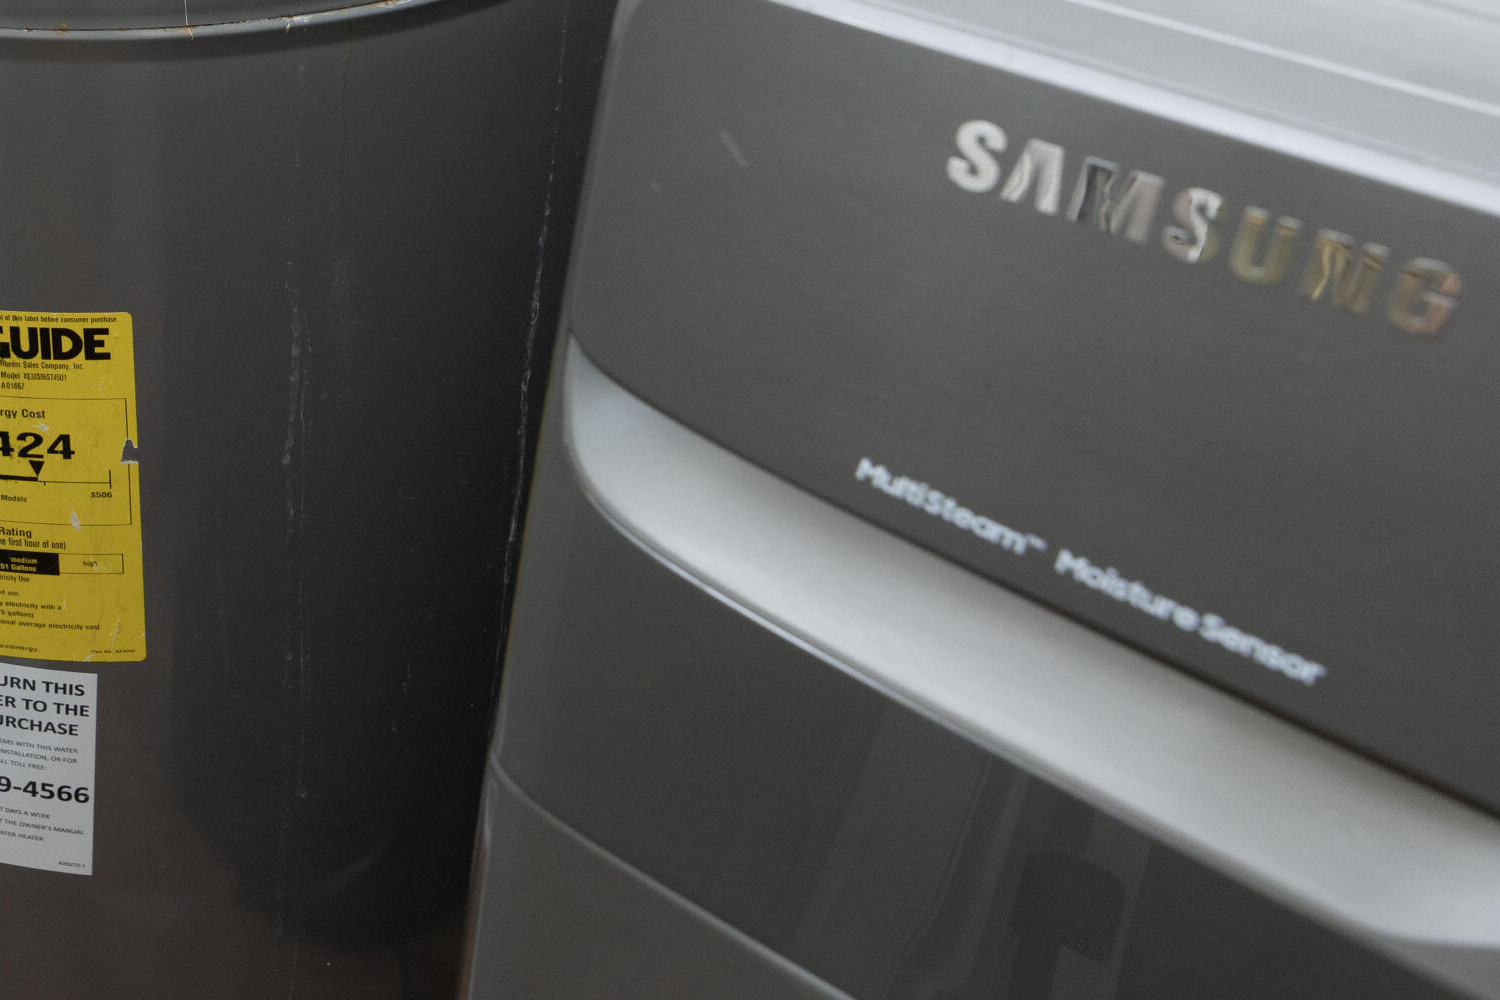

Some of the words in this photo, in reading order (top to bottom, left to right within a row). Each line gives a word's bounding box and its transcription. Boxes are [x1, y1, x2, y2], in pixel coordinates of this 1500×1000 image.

[946, 119, 1462, 336] SAMSUNG
[0, 360, 21, 368] Rheem
[23, 361, 39, 369] Sales
[1, 372, 20, 380] Model
[22, 409, 46, 419] Cost
[9, 538, 22, 546] first
[25, 539, 40, 548] hour
[52, 542, 66, 551] use)
[1054, 548, 1199, 633] Moisture
[1199, 612, 1328, 687] Sensor
[43, 681, 85, 696] THIS
[22, 698, 48, 712] TO
[53, 702, 90, 717] THE
[11, 760, 26, 768] TOLL
[53, 826, 84, 835] MANUAL
[18, 833, 44, 841] HEATER
